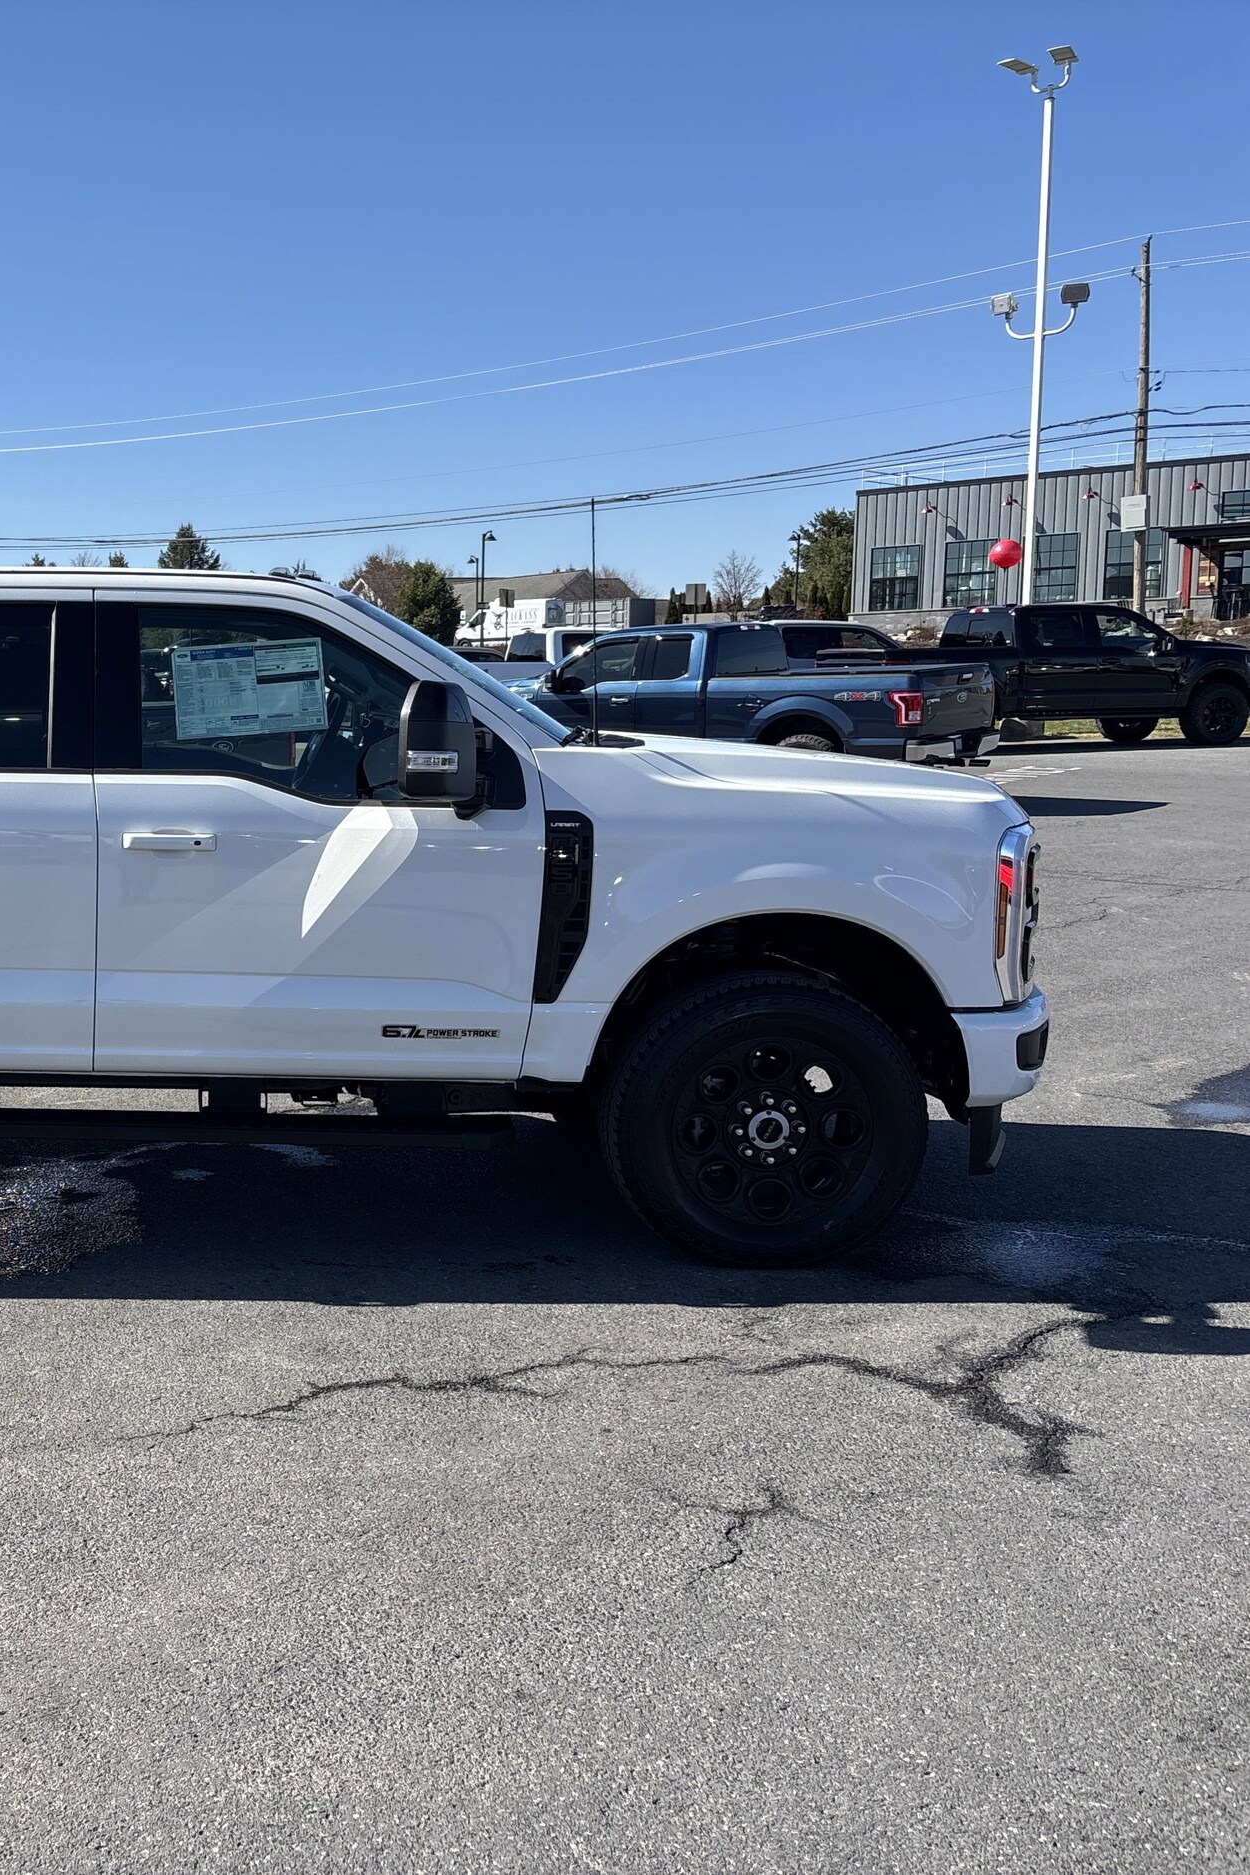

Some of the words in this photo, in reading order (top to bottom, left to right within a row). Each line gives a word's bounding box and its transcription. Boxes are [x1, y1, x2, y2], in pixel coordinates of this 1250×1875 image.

[382, 1025, 425, 1038] 6.7L
[426, 1029, 459, 1037] POWER
[461, 1029, 498, 1038] STROKE
